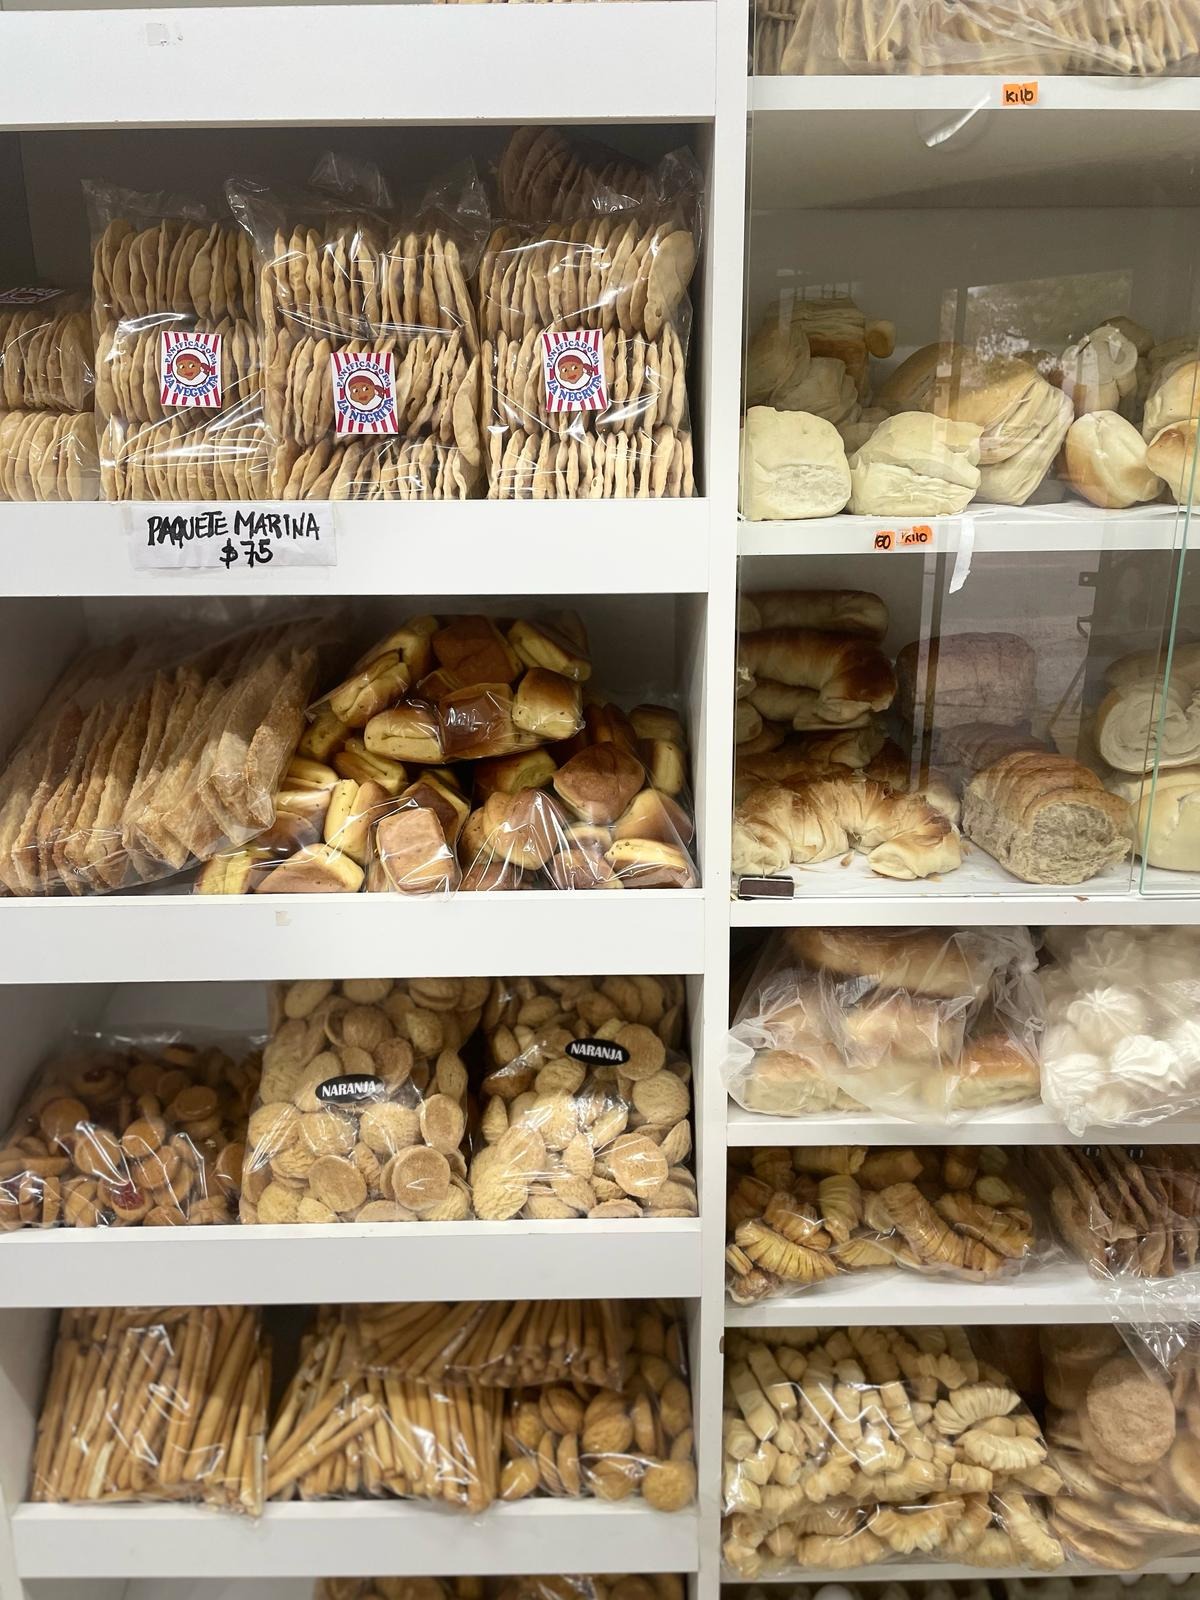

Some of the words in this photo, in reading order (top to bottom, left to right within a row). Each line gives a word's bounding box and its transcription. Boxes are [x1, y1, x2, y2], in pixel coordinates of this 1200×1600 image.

[164, 341, 217, 365] PANIFICADORA
[547, 340, 600, 368] PANIFICADORA
[163, 374, 175, 388] LA
[174, 374, 218, 397] NEGRITA
[337, 361, 391, 388] PANIFICADORA
[547, 380, 559, 395] LA
[558, 374, 602, 402] NEGRITA
[337, 400, 349, 415] LA
[349, 397, 394, 423] NEGRITA
[147, 511, 228, 549] PAQUETE
[233, 510, 321, 541] MARINA
[219, 537, 274, 569] $75
[570, 1043, 623, 1061] NARANJA
[321, 1080, 377, 1097] NARANJA
